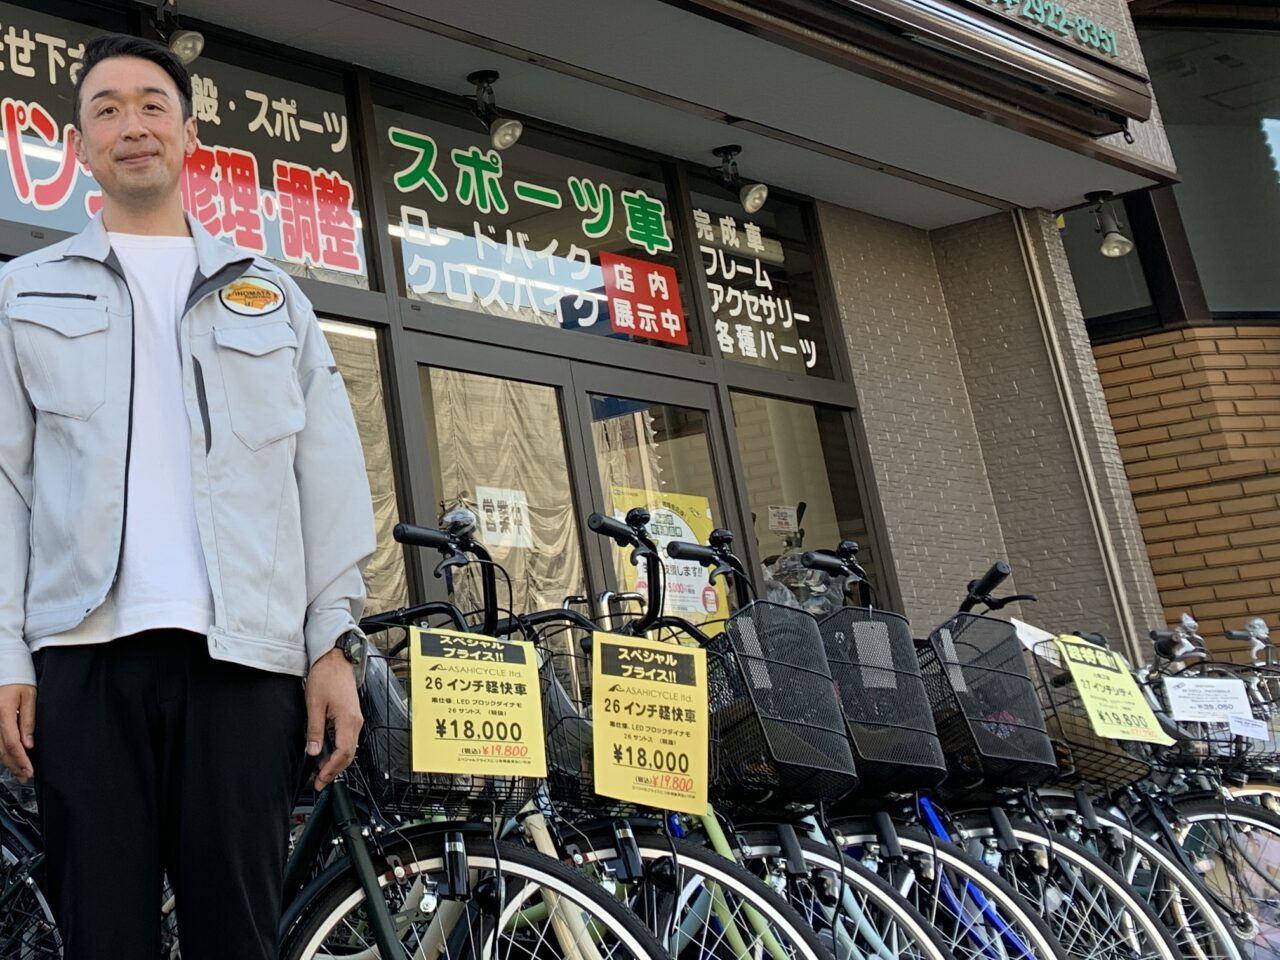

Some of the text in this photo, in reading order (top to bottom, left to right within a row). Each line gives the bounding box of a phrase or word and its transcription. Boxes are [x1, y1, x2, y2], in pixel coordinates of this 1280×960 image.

[388, 126, 673, 256] スポーツ車
[400, 205, 591, 280] ロードバイク
[692, 208, 765, 253] 完成車
[613, 263, 669, 300] 店内
[699, 245, 772, 290] フレーム
[408, 254, 599, 327] クロスバイク
[706, 282, 810, 328] アクセサリー
[613, 298, 681, 338] 展示中
[715, 319, 817, 368] 各種パーツ
[448, 664, 507, 677] ASAHICYCLE
[618, 648, 678, 667] スペシャル
[425, 676, 443, 690] 26
[625, 687, 679, 701] ASAHICYCLE
[604, 698, 621, 713] 26
[1097, 709, 1149, 728] ¥19,800
[435, 718, 522, 742] ¥18,000
[613, 743, 690, 774] ¥18,000
